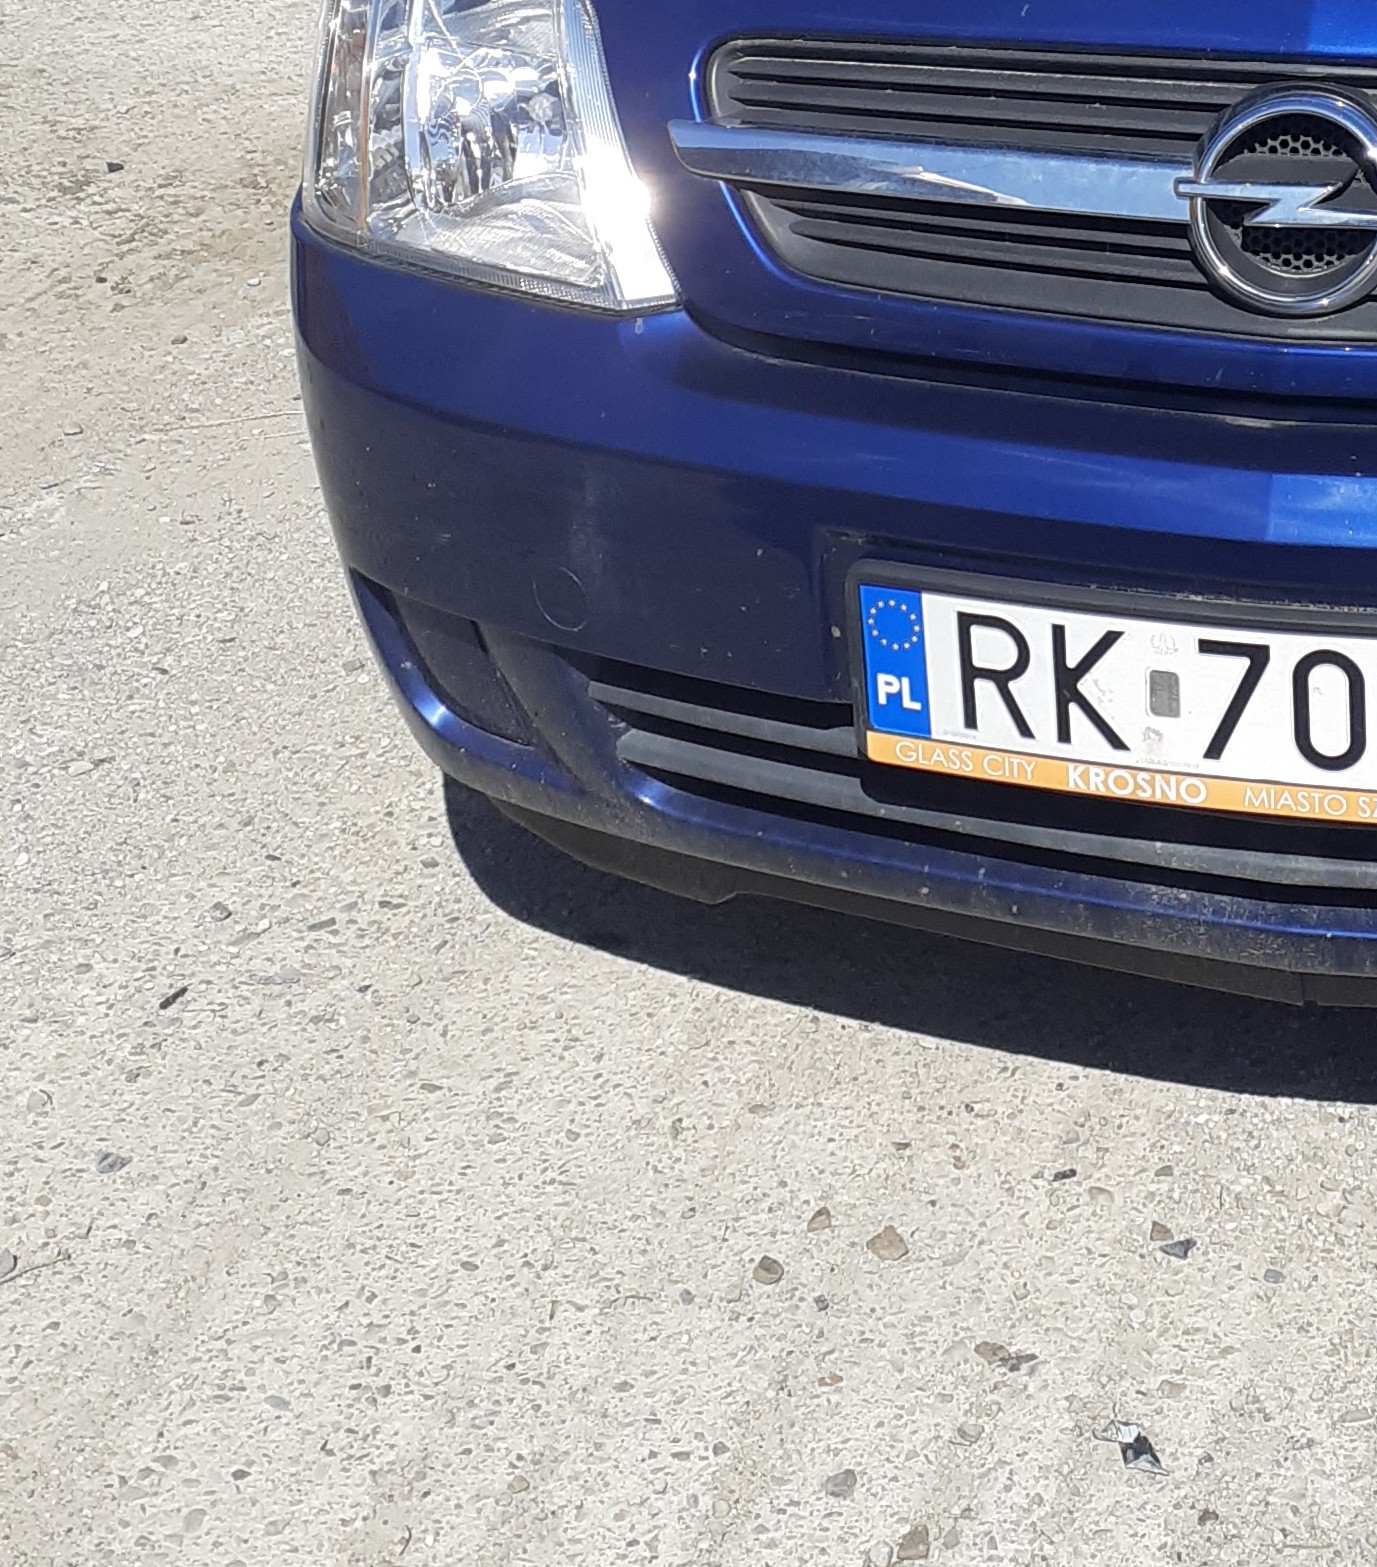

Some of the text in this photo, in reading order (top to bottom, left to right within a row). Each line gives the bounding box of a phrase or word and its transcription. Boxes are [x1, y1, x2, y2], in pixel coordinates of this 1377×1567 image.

[878, 675, 921, 710] PL
[957, 611, 1130, 751] RK
[895, 740, 974, 773] GLASS
[983, 755, 1037, 779] CITY
[1067, 764, 1208, 805] KROSNO
[1244, 787, 1347, 814] MIASTO
